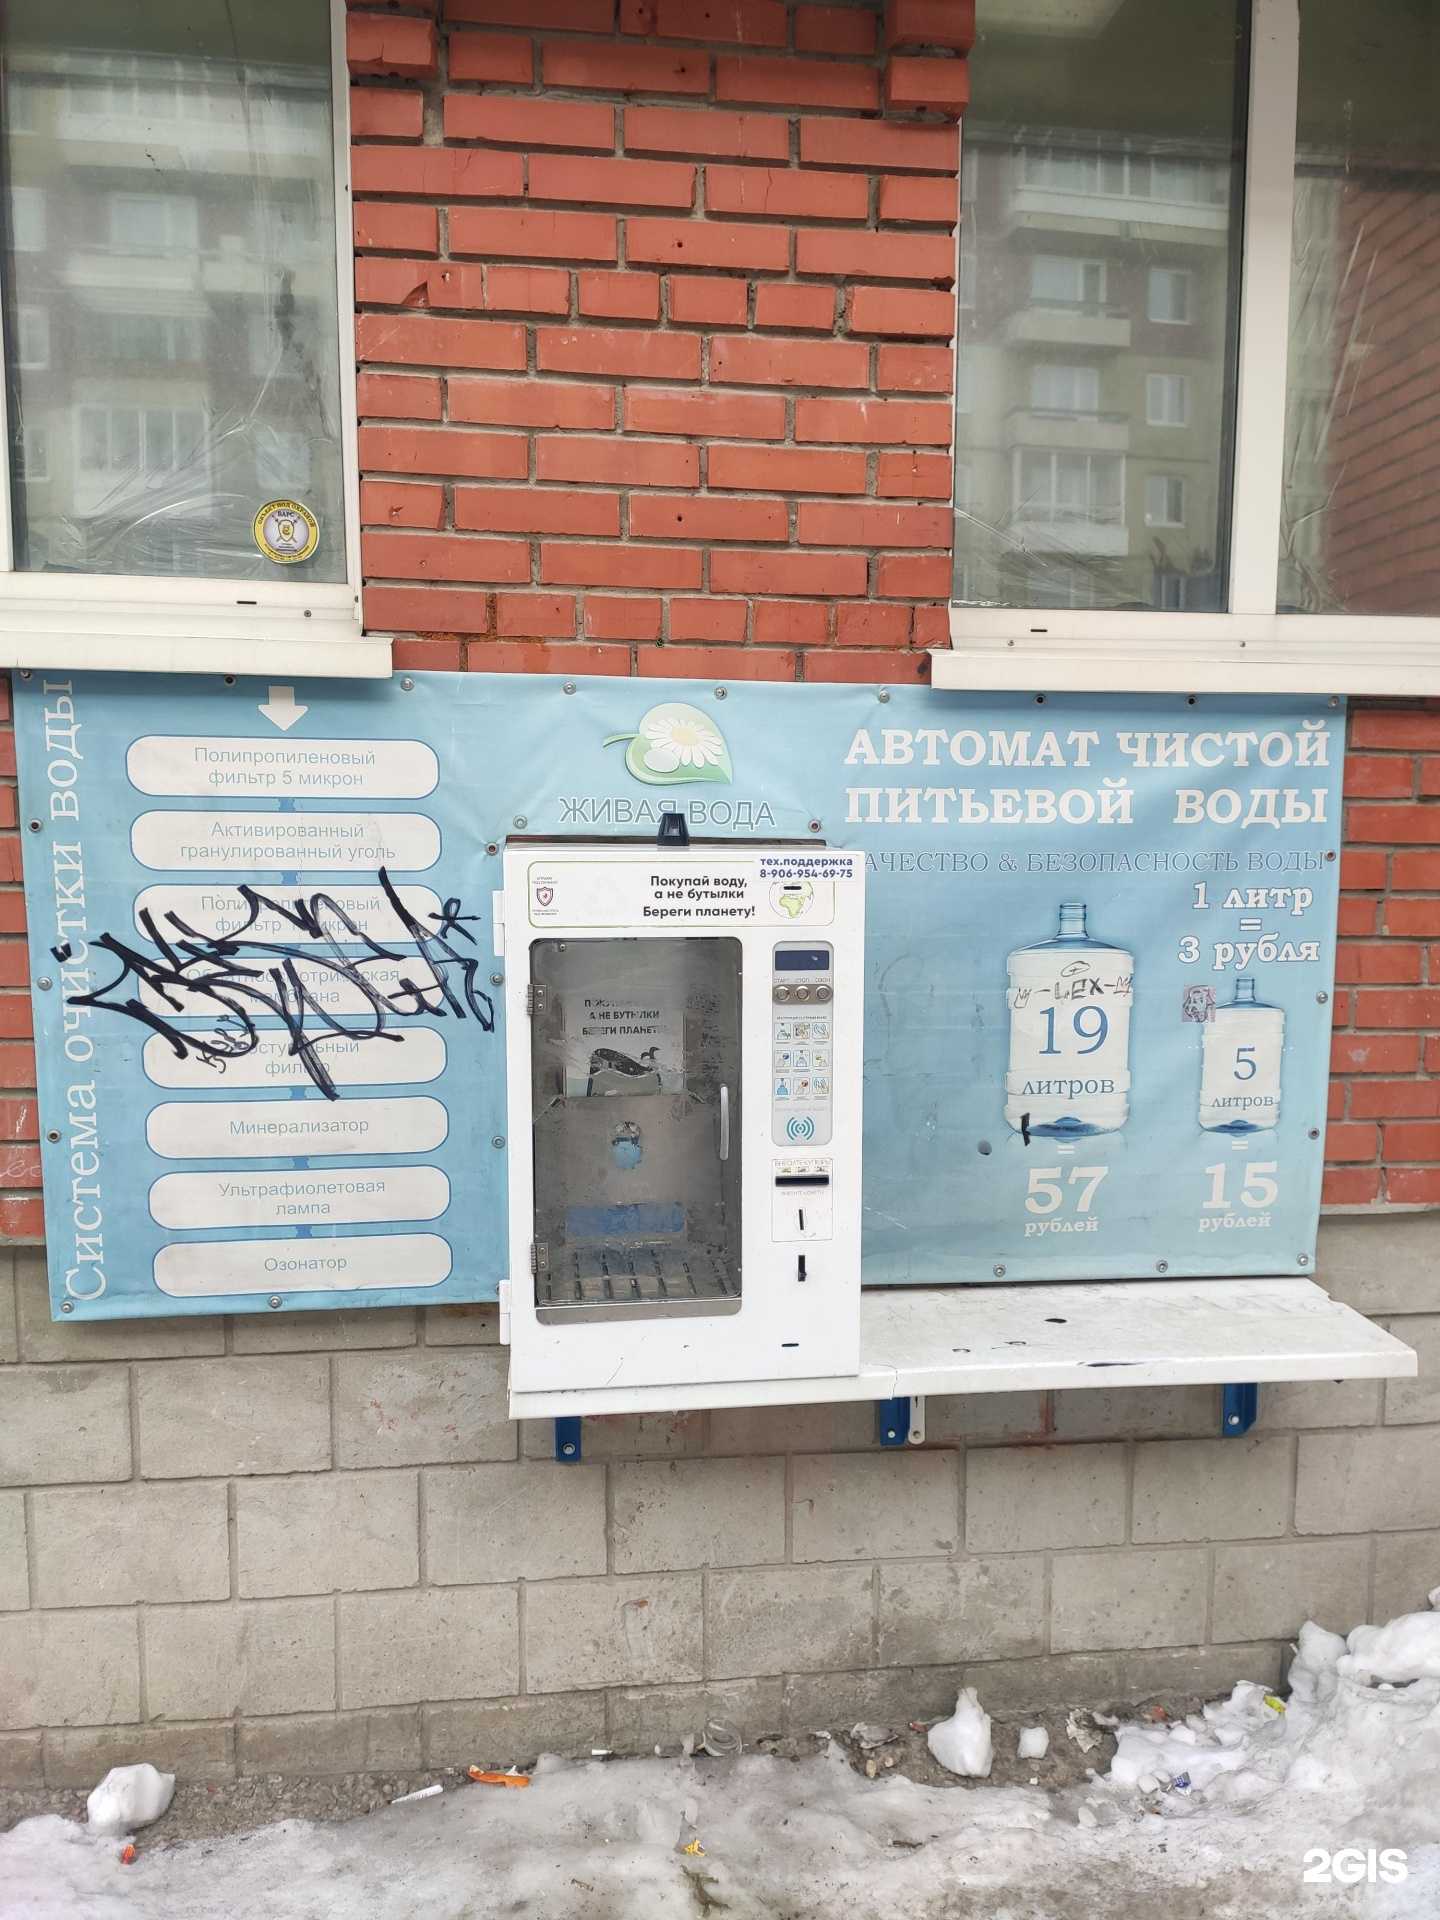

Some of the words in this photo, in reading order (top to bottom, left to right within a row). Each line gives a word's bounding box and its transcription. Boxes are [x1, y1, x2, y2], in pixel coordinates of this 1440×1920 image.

[43, 680, 83, 822] воды
[843, 728, 1099, 766] АВТОМАТ
[1116, 719, 1330, 767] ЧИСТОЙ
[194, 747, 376, 766] Полипропиленовый
[208, 770, 276, 786] фильтр
[282, 770, 292, 784] 5
[298, 774, 364, 787] микрон
[844, 776, 1135, 825] ПИТЬЕВОЙ
[1173, 787, 1328, 830] ВОДЫ
[559, 797, 678, 824] ЖИВАЯ
[688, 800, 777, 830] ВОДА
[211, 823, 364, 840] Активированный
[180, 845, 342, 862] гранулированный
[347, 847, 397, 862] уголь
[760, 856, 853, 868] тех.поддержка
[864, 850, 990, 873] АЧЕСТВО
[997, 854, 1018, 873] &
[1026, 852, 1240, 874] БЕЗОПАСНОСТЬ
[1247, 852, 1326, 875] ВОДЫ
[650, 875, 709, 889] Покупай
[714, 877, 748, 889] воду,
[760, 869, 853, 879] 8-906-954-69-75
[654, 891, 663, 899] а
[667, 891, 684, 899] не
[688, 888, 744, 900] бутылки
[1193, 883, 1210, 909] 1
[1222, 887, 1313, 916] литр
[643, 904, 691, 920] Береги
[696, 905, 756, 920] планету!
[50, 841, 94, 1062] очистки
[1178, 935, 1201, 964] 3
[1212, 933, 1320, 970] рубля
[1038, 1004, 1108, 1055] 19
[1233, 1046, 1257, 1080] 5
[1021, 1080, 1115, 1099] литров
[1211, 1096, 1274, 1110] литров
[229, 1119, 369, 1136] Минерализатор
[64, 1079, 106, 1301] Система
[218, 1180, 386, 1199] Ультрафиолетовая
[1025, 1166, 1109, 1214] 57
[1202, 1161, 1279, 1209] 15
[275, 1202, 331, 1217] лампа
[1024, 1215, 1101, 1237] рублей
[1199, 1211, 1272, 1233] рублей
[263, 1256, 348, 1273] Озонатор
